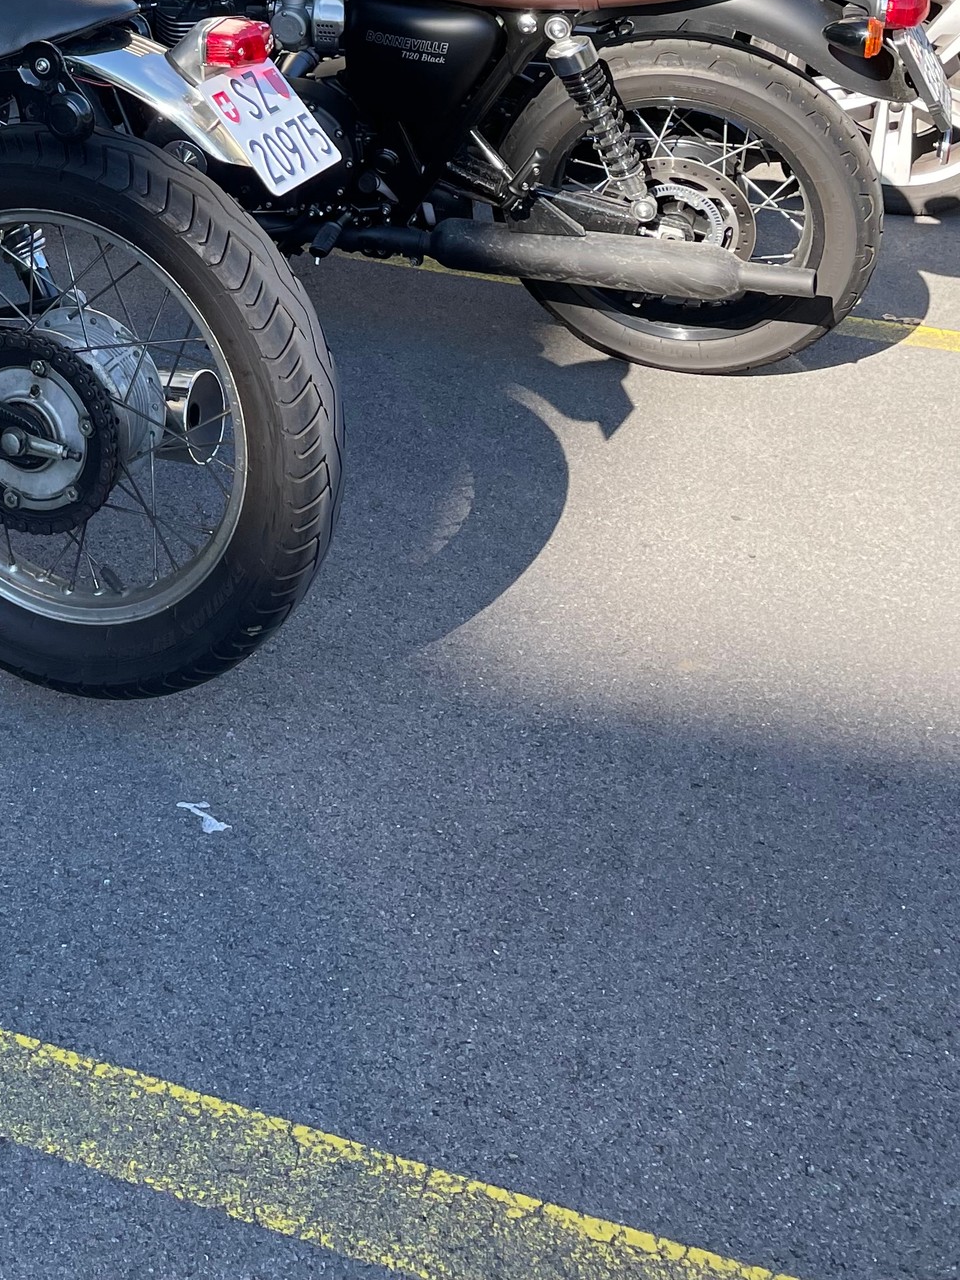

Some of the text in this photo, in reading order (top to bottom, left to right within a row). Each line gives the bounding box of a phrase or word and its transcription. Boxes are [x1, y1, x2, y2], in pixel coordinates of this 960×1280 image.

[366, 30, 449, 55] BONNEVILLE
[401, 50, 446, 64] T120 Black
[230, 70, 280, 120] SZ
[248, 113, 333, 186] 20975
